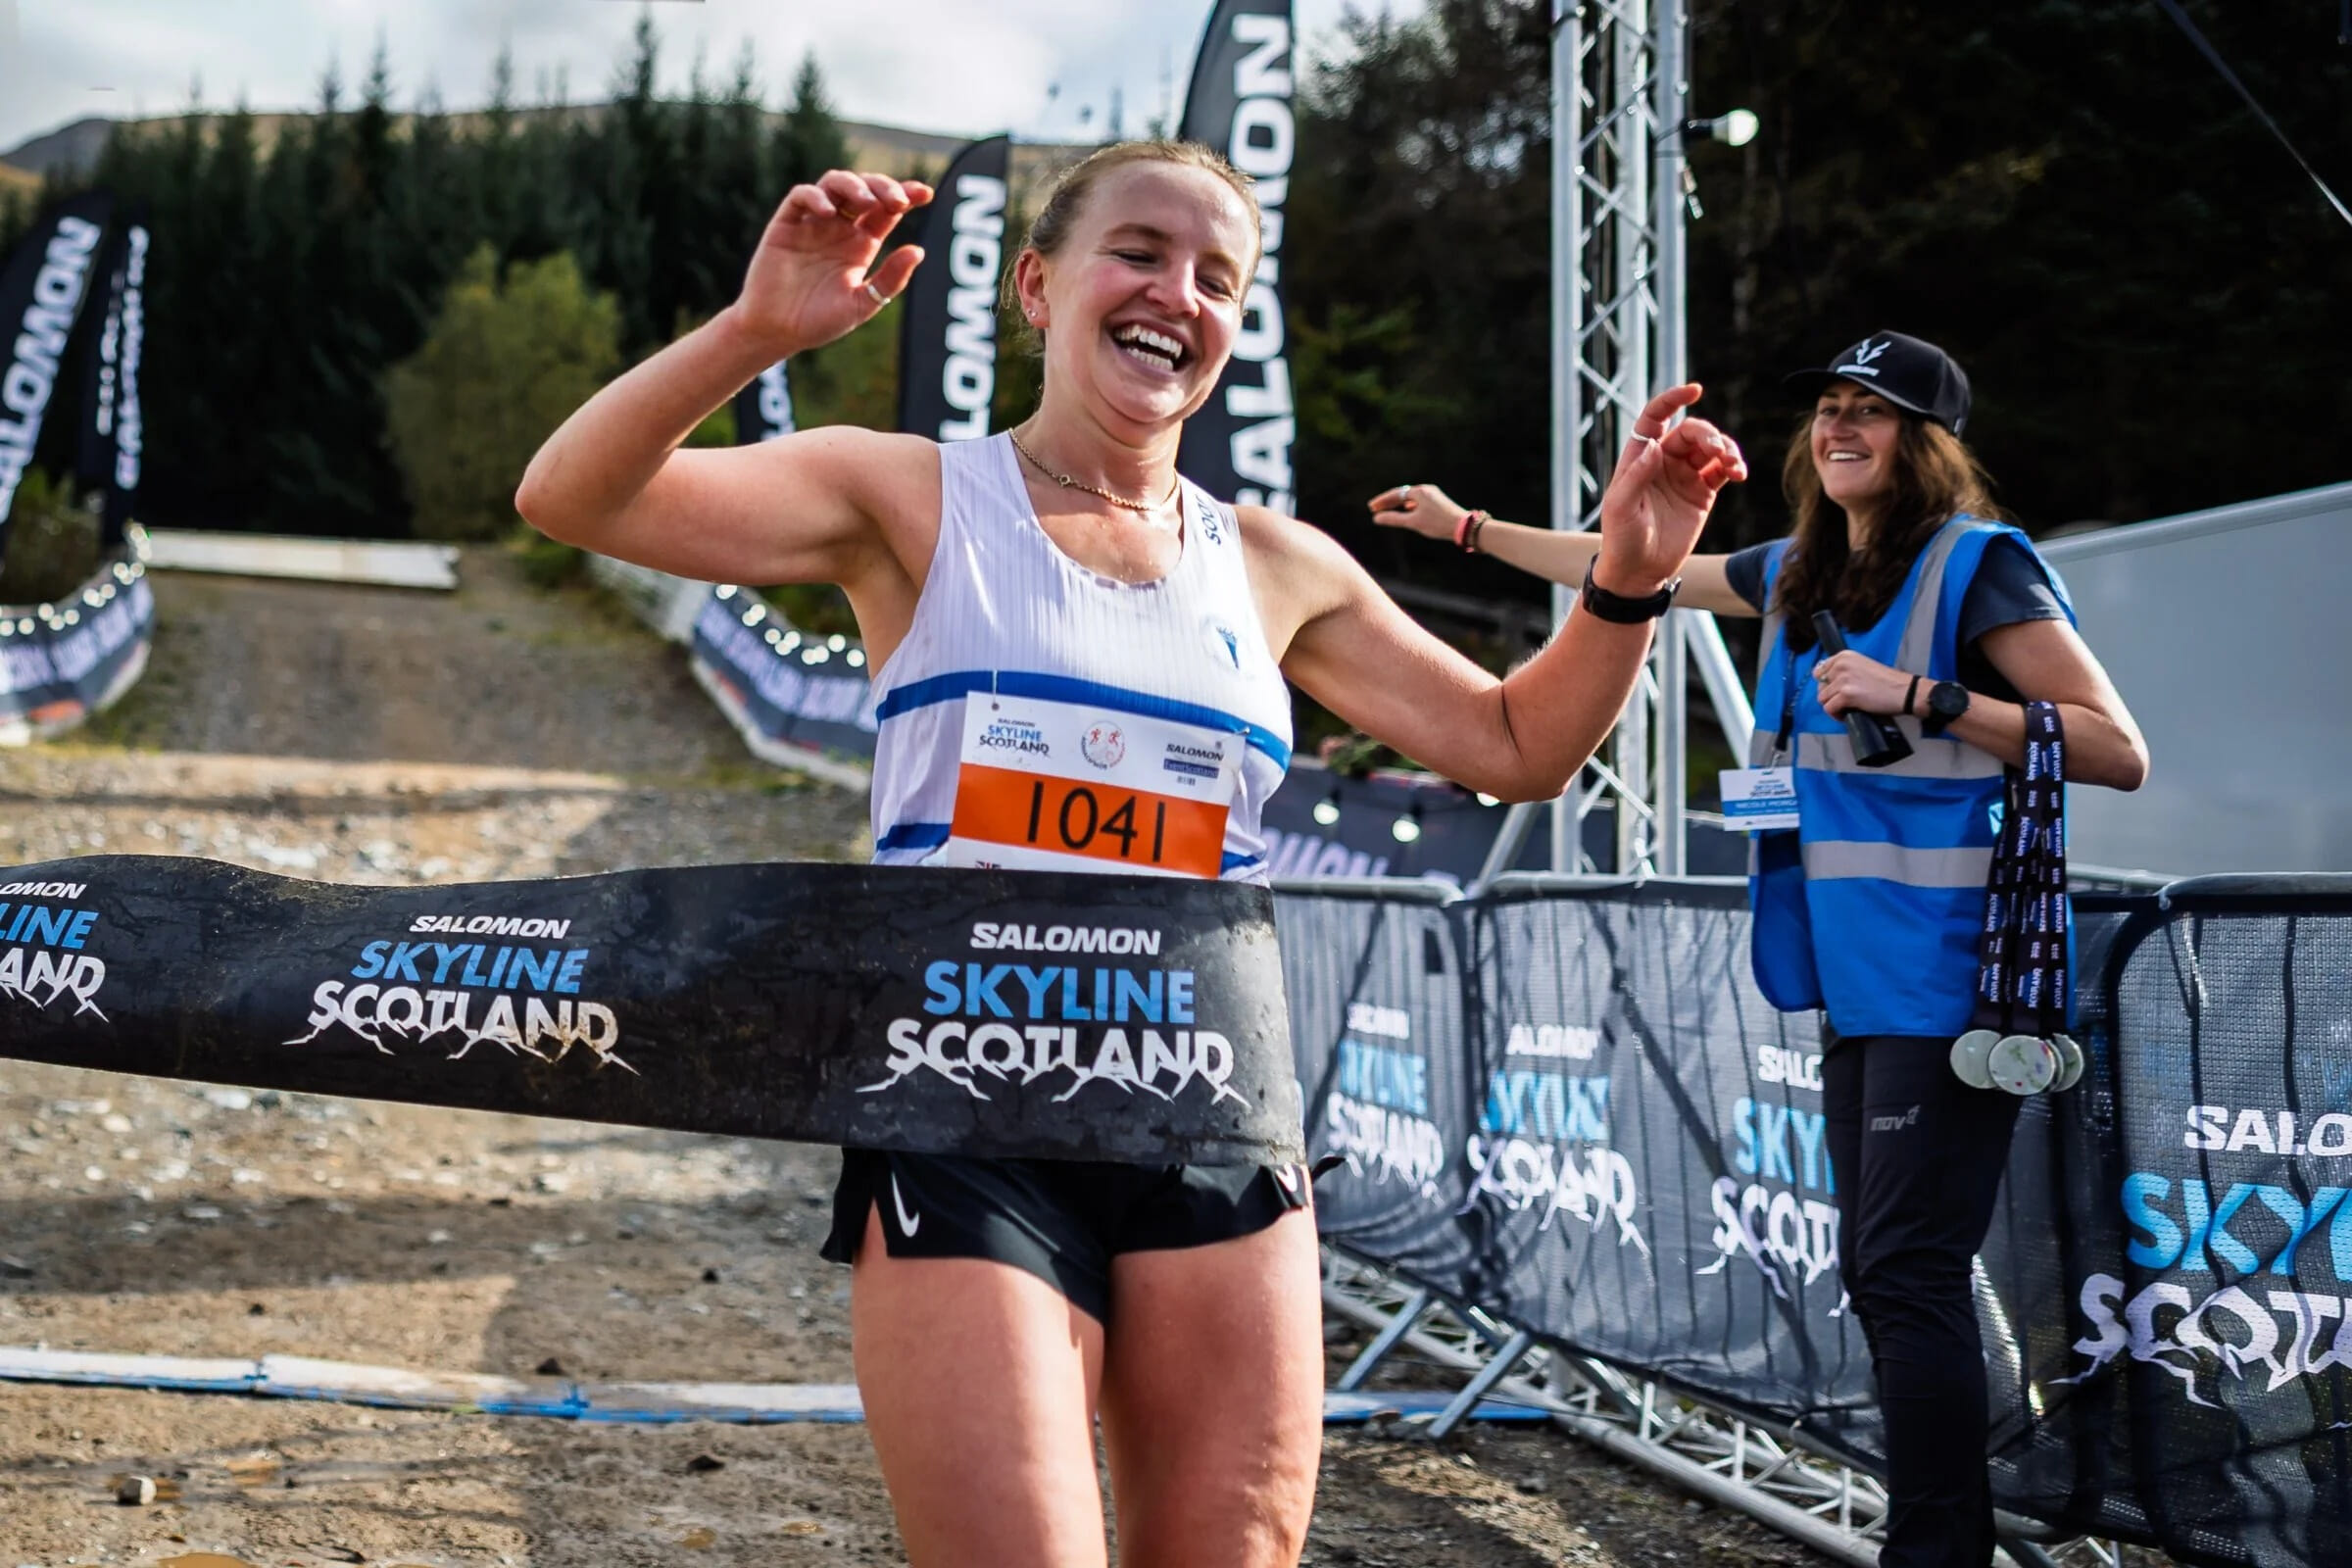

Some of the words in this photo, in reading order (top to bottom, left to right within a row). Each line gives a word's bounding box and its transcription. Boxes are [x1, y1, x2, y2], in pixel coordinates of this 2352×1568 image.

[1228, 13, 1297, 517] ALOMON
[0, 216, 101, 524] ALOMON
[979, 734, 1052, 758] SCOTLAND
[987, 724, 1043, 742] SKYLINE
[1165, 744, 1225, 762] SALOMON
[1027, 780, 1167, 863] 1041
[0, 882, 86, 899] OMON
[410, 915, 570, 940] SALOMON
[970, 922, 1161, 956] SALOMON
[351, 940, 590, 994] SKYLINE
[922, 960, 1196, 1024] SKYLINE
[282, 980, 642, 1076] SCOTLAND
[856, 1017, 1253, 1109] SCOTLAND
[1734, 1097, 1836, 1196] SKY
